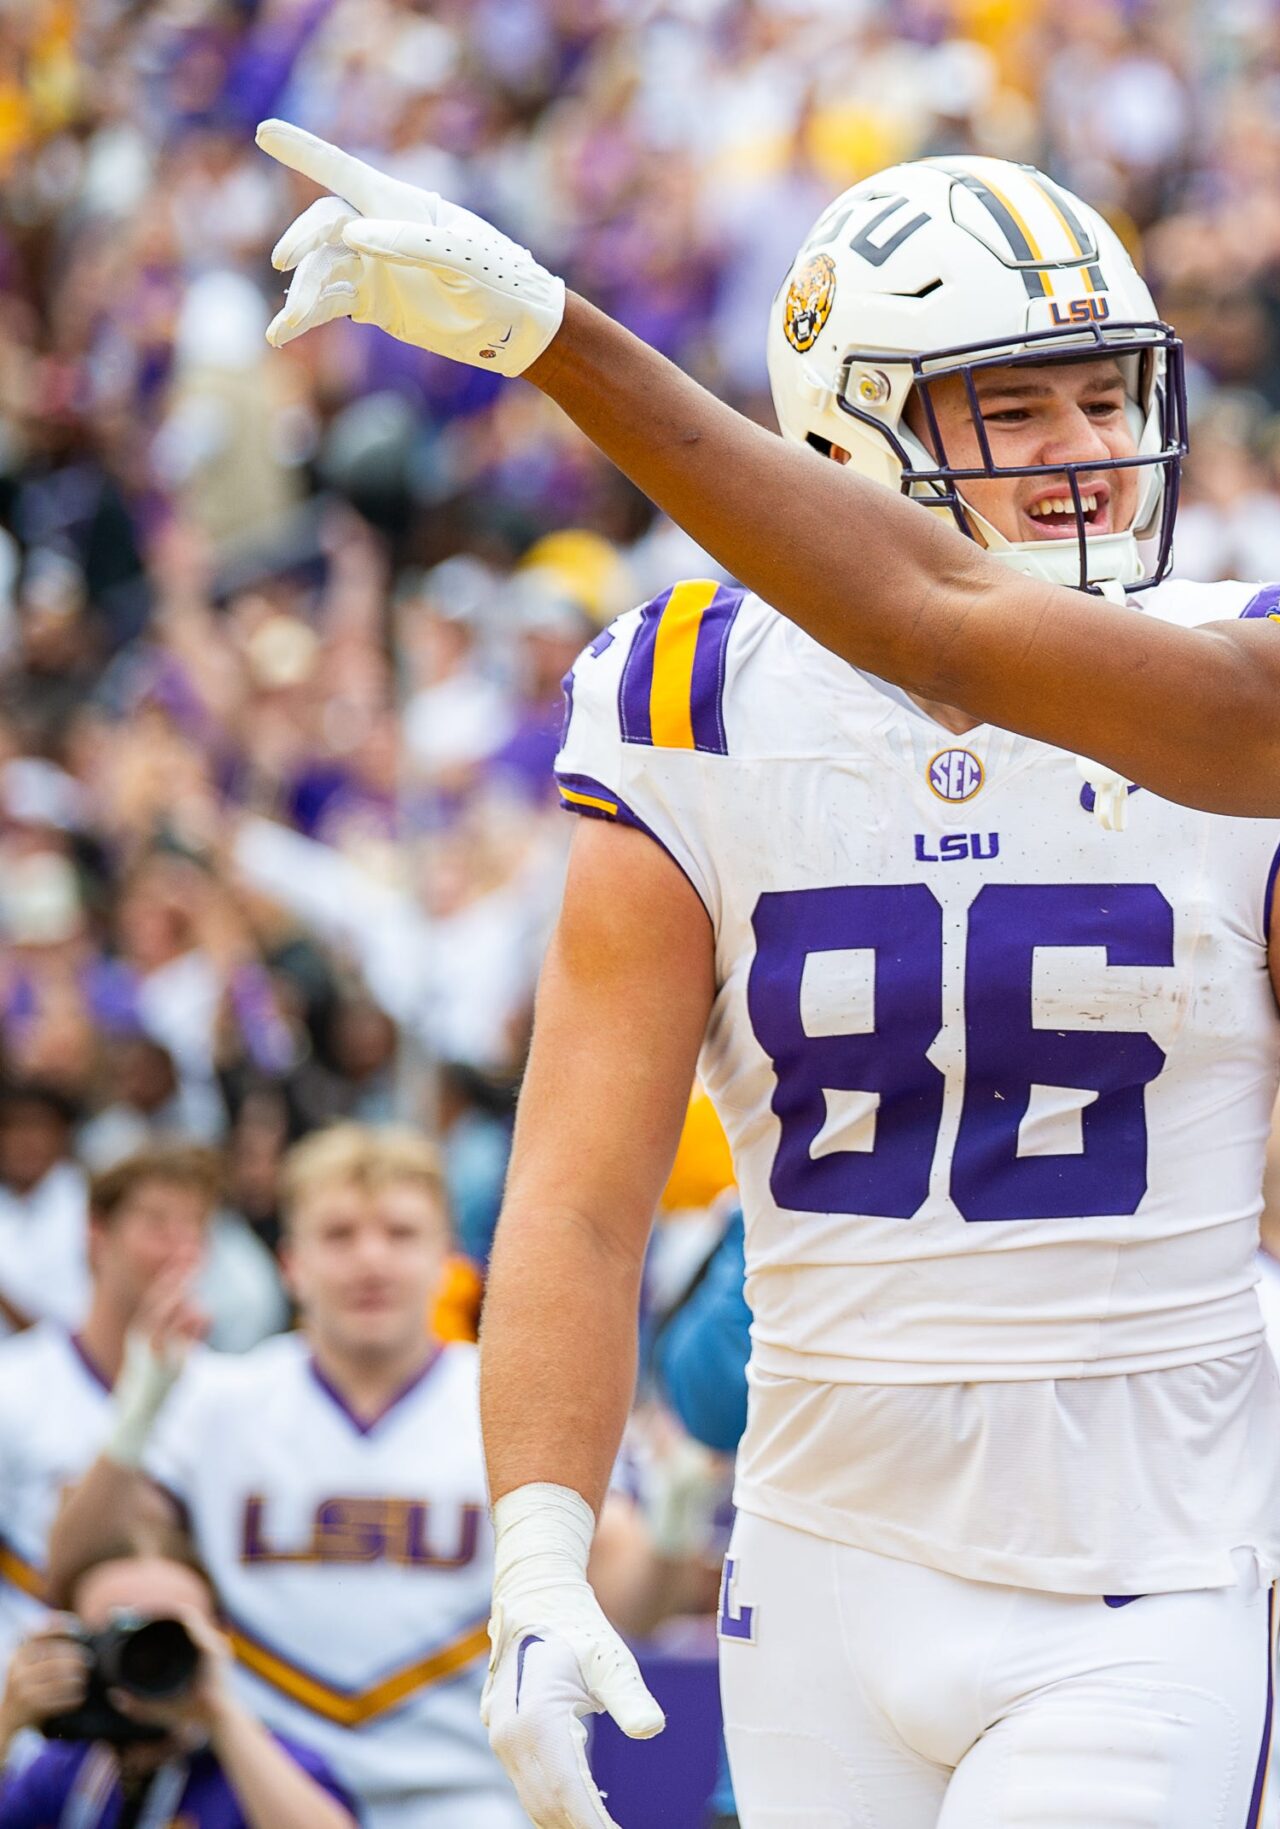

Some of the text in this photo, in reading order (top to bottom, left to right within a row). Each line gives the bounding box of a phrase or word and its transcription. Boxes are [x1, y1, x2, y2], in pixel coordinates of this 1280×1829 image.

[1048, 297, 1110, 326] LSU
[928, 749, 982, 800] SEC
[913, 832, 1000, 862] LSU
[746, 882, 1175, 1223] 86
[240, 1495, 483, 1568] LSU
